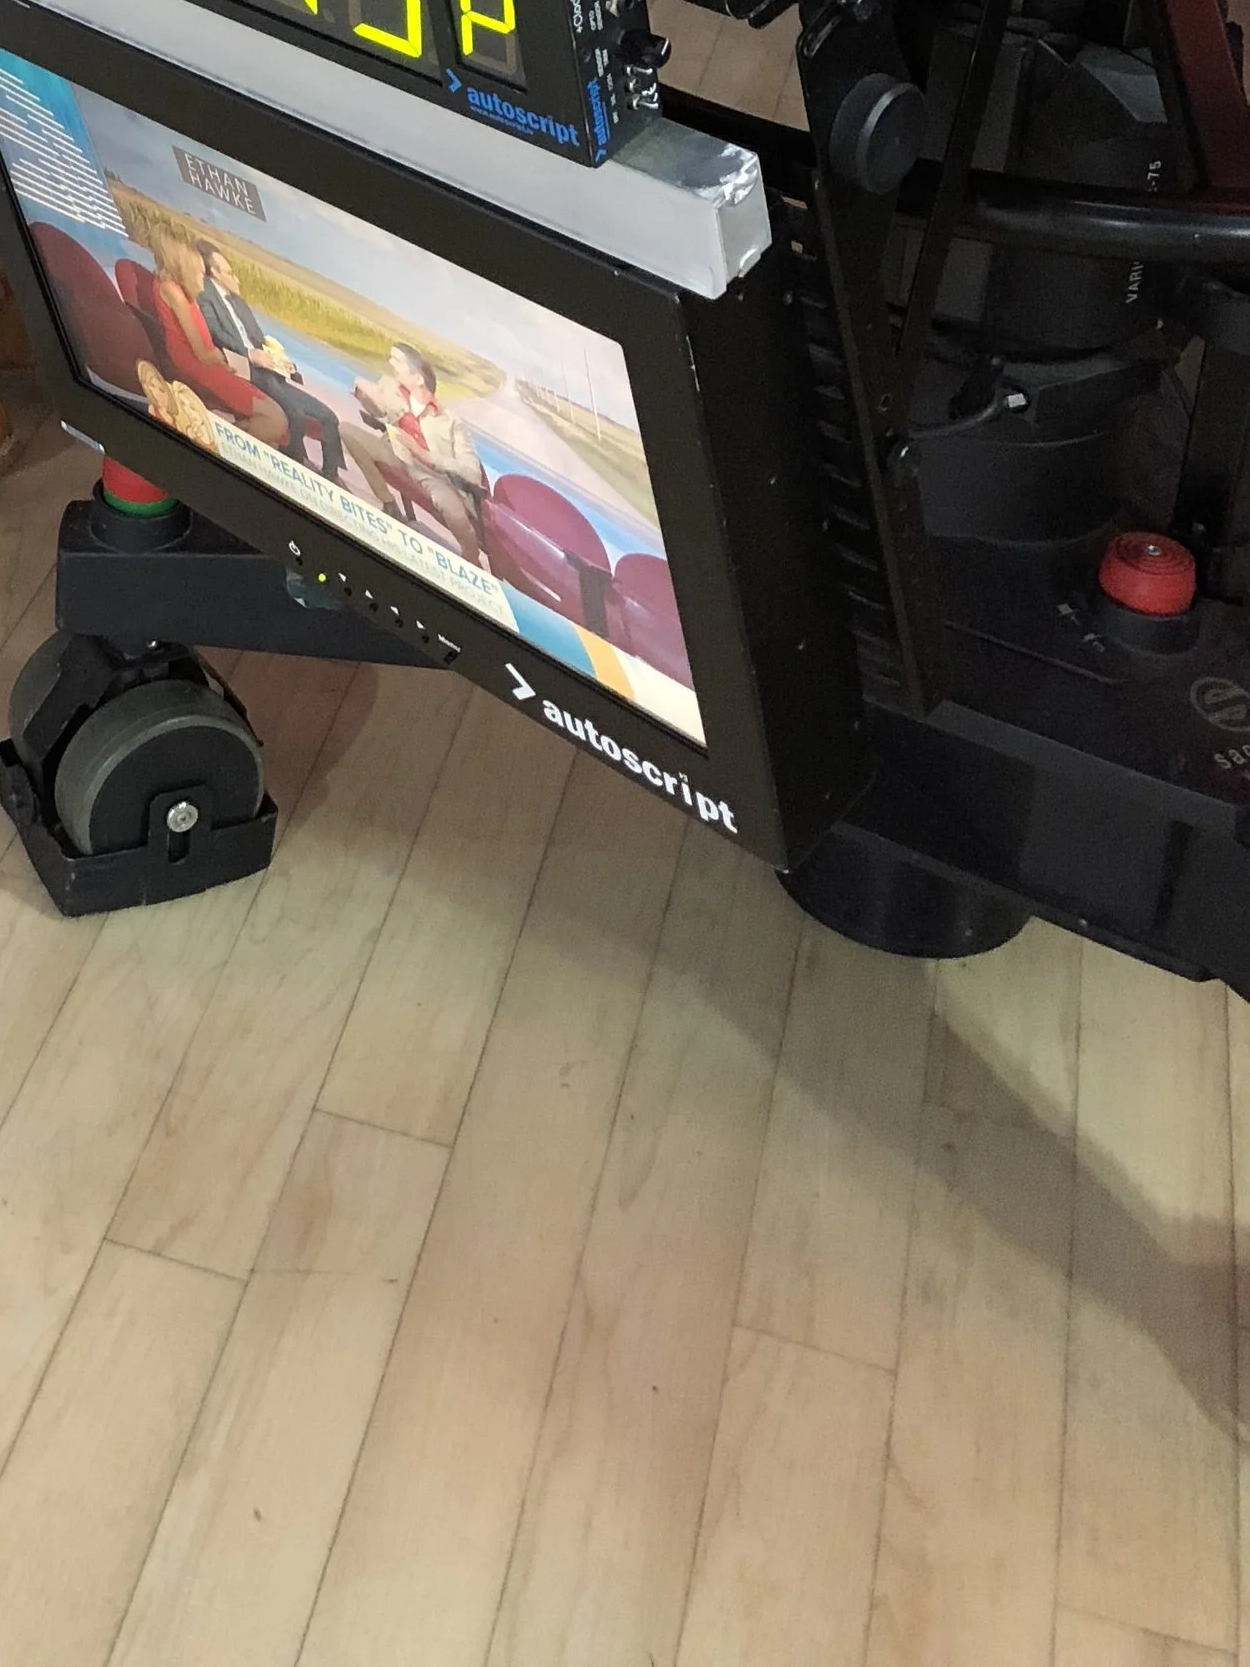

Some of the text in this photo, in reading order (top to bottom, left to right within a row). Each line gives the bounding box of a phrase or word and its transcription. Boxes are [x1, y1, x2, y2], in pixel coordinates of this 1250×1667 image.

[466, 86, 580, 147] autoscript
[184, 153, 249, 197] ETHAN
[188, 169, 256, 215] HAWKE
[1125, 261, 1144, 304] VARI
[214, 422, 498, 596] FROM "REALITY BITES" TO "BLAZE"
[542, 700, 738, 834] autoscript
